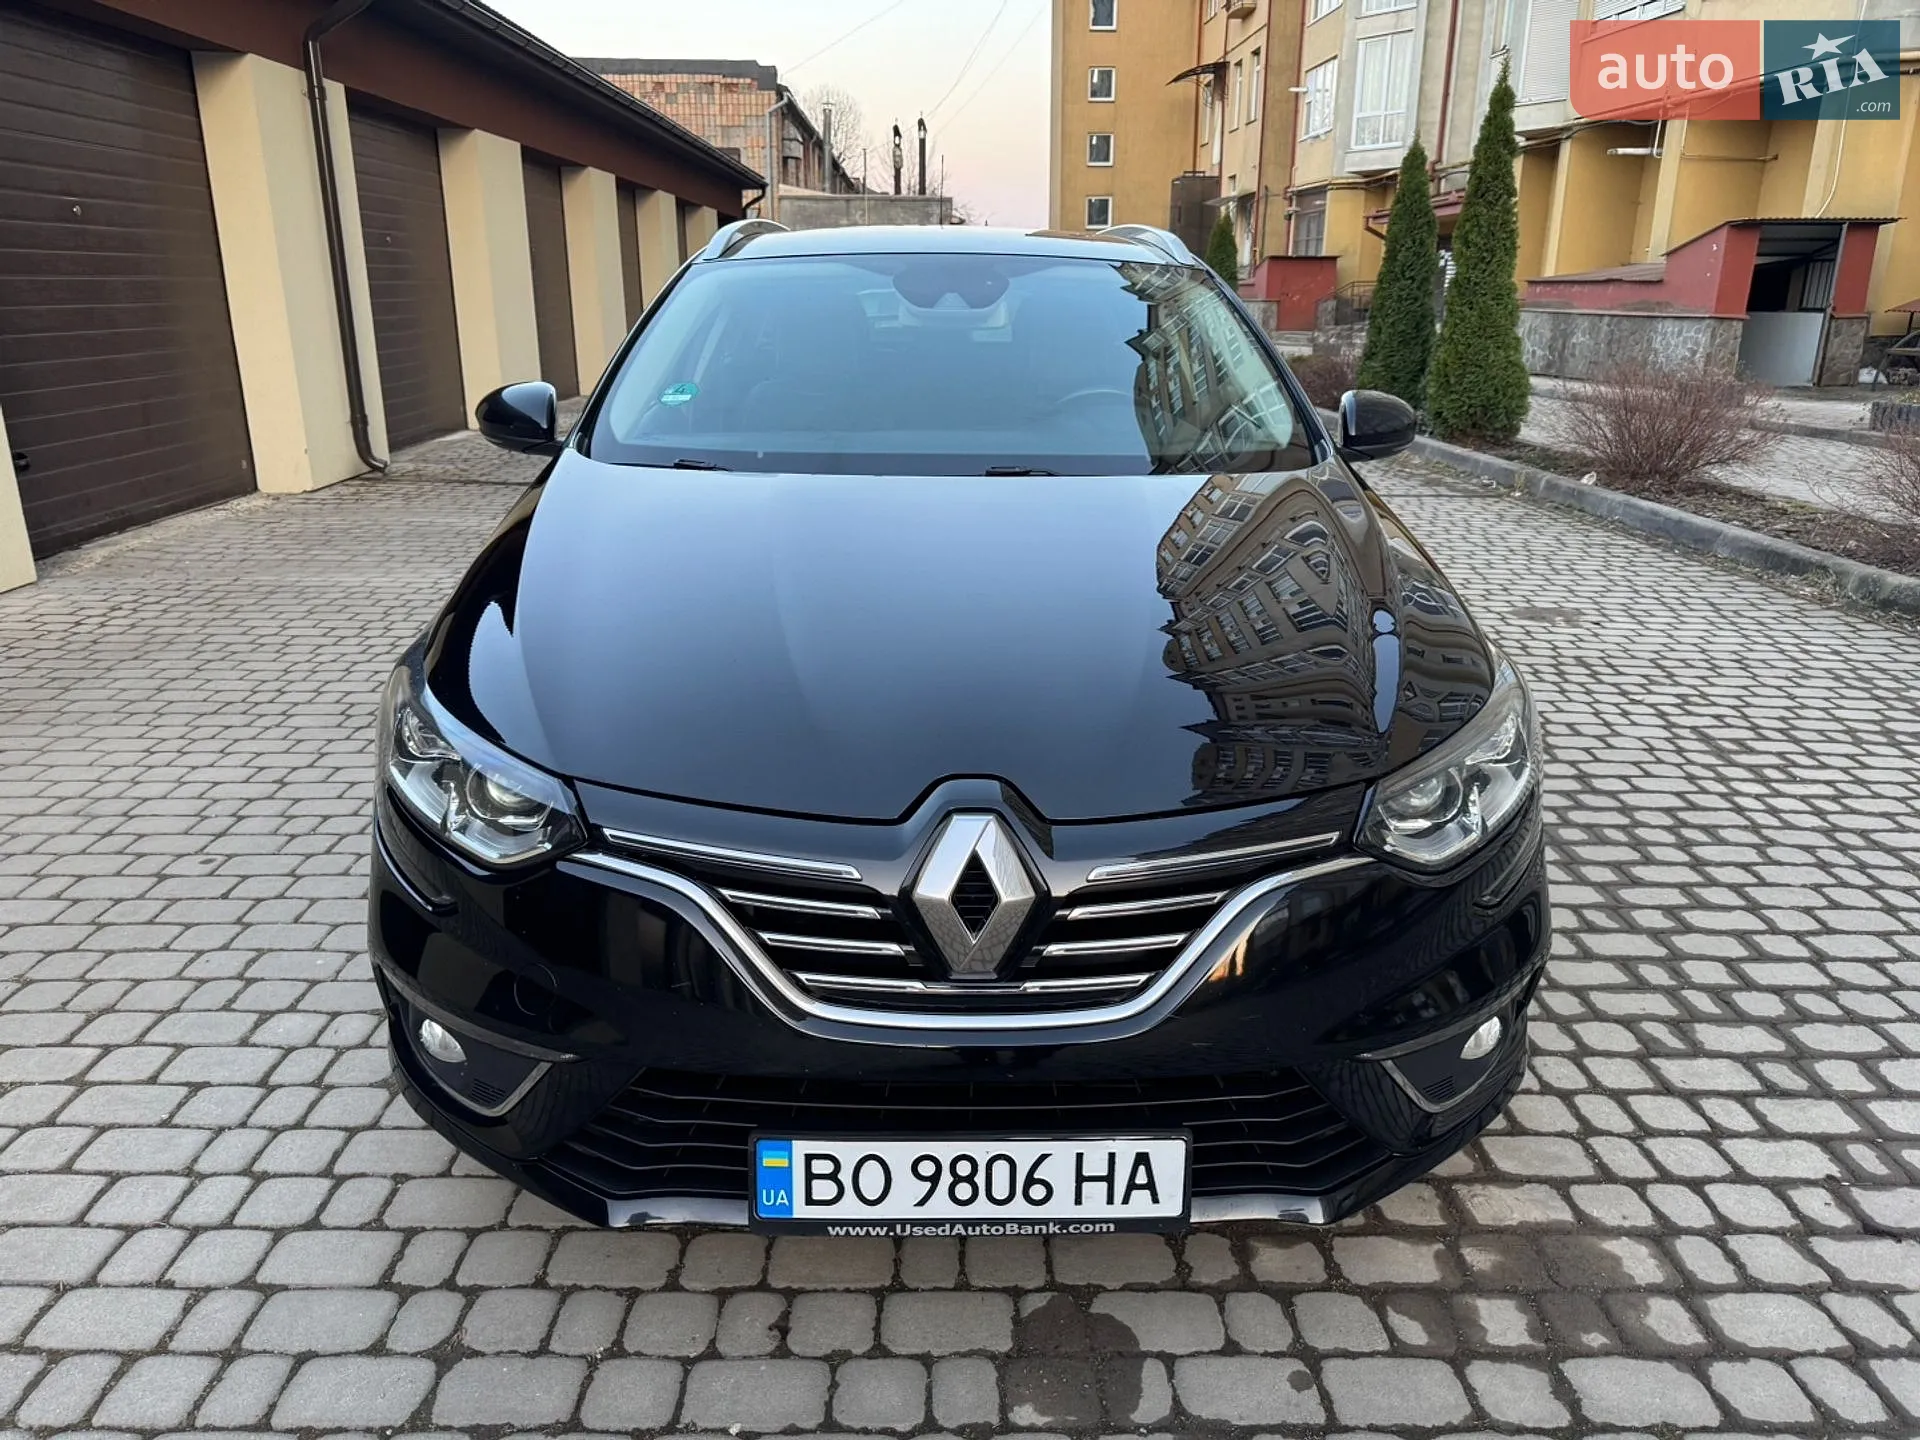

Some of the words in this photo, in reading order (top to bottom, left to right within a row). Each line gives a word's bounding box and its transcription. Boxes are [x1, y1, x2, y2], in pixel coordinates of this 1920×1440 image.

[804, 1153, 892, 1207] BO
[910, 1153, 1055, 1207] 9806
[1074, 1152, 1160, 1206] HA
[762, 1189, 789, 1206] UA
[827, 1220, 1116, 1237] www.UsedAutoBank.com
